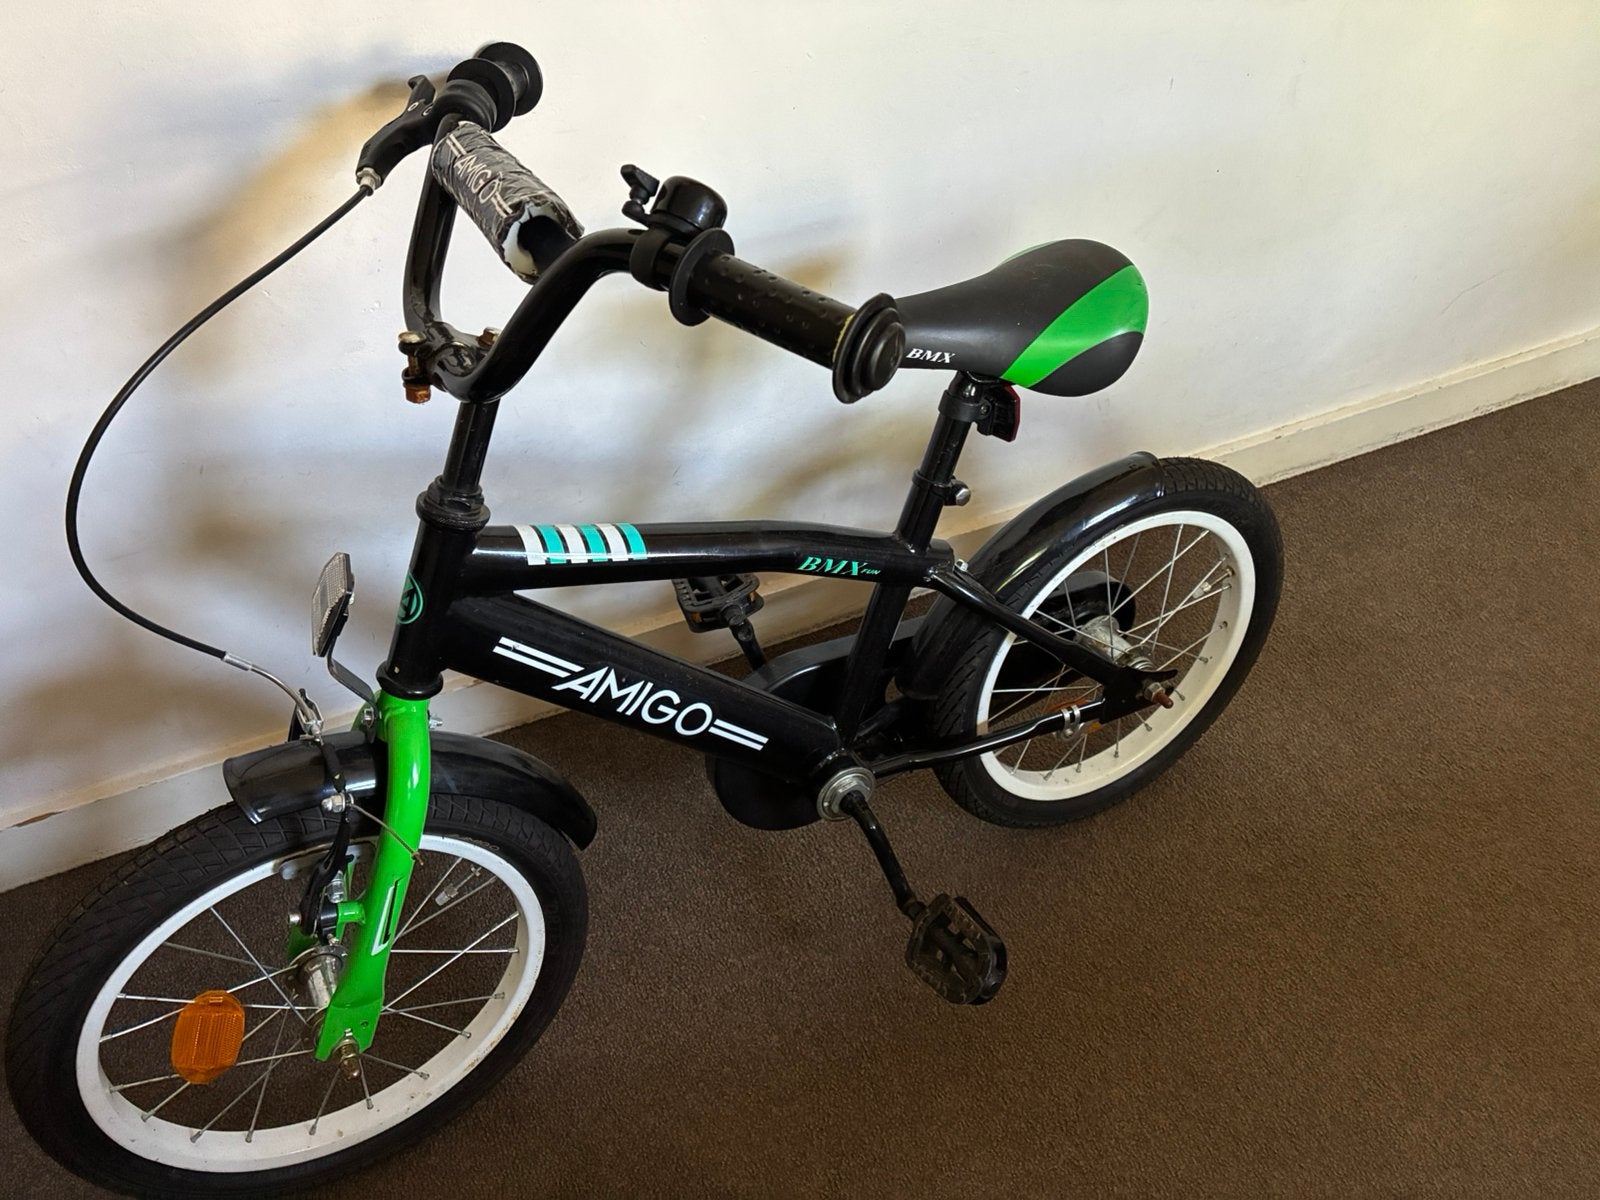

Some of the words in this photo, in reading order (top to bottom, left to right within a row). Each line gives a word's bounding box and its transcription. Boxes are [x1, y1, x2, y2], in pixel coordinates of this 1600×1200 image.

[453, 155, 502, 204] AMIGO
[906, 348, 956, 363] BMX
[797, 556, 868, 576] BMX
[551, 666, 713, 736] AMIGO
